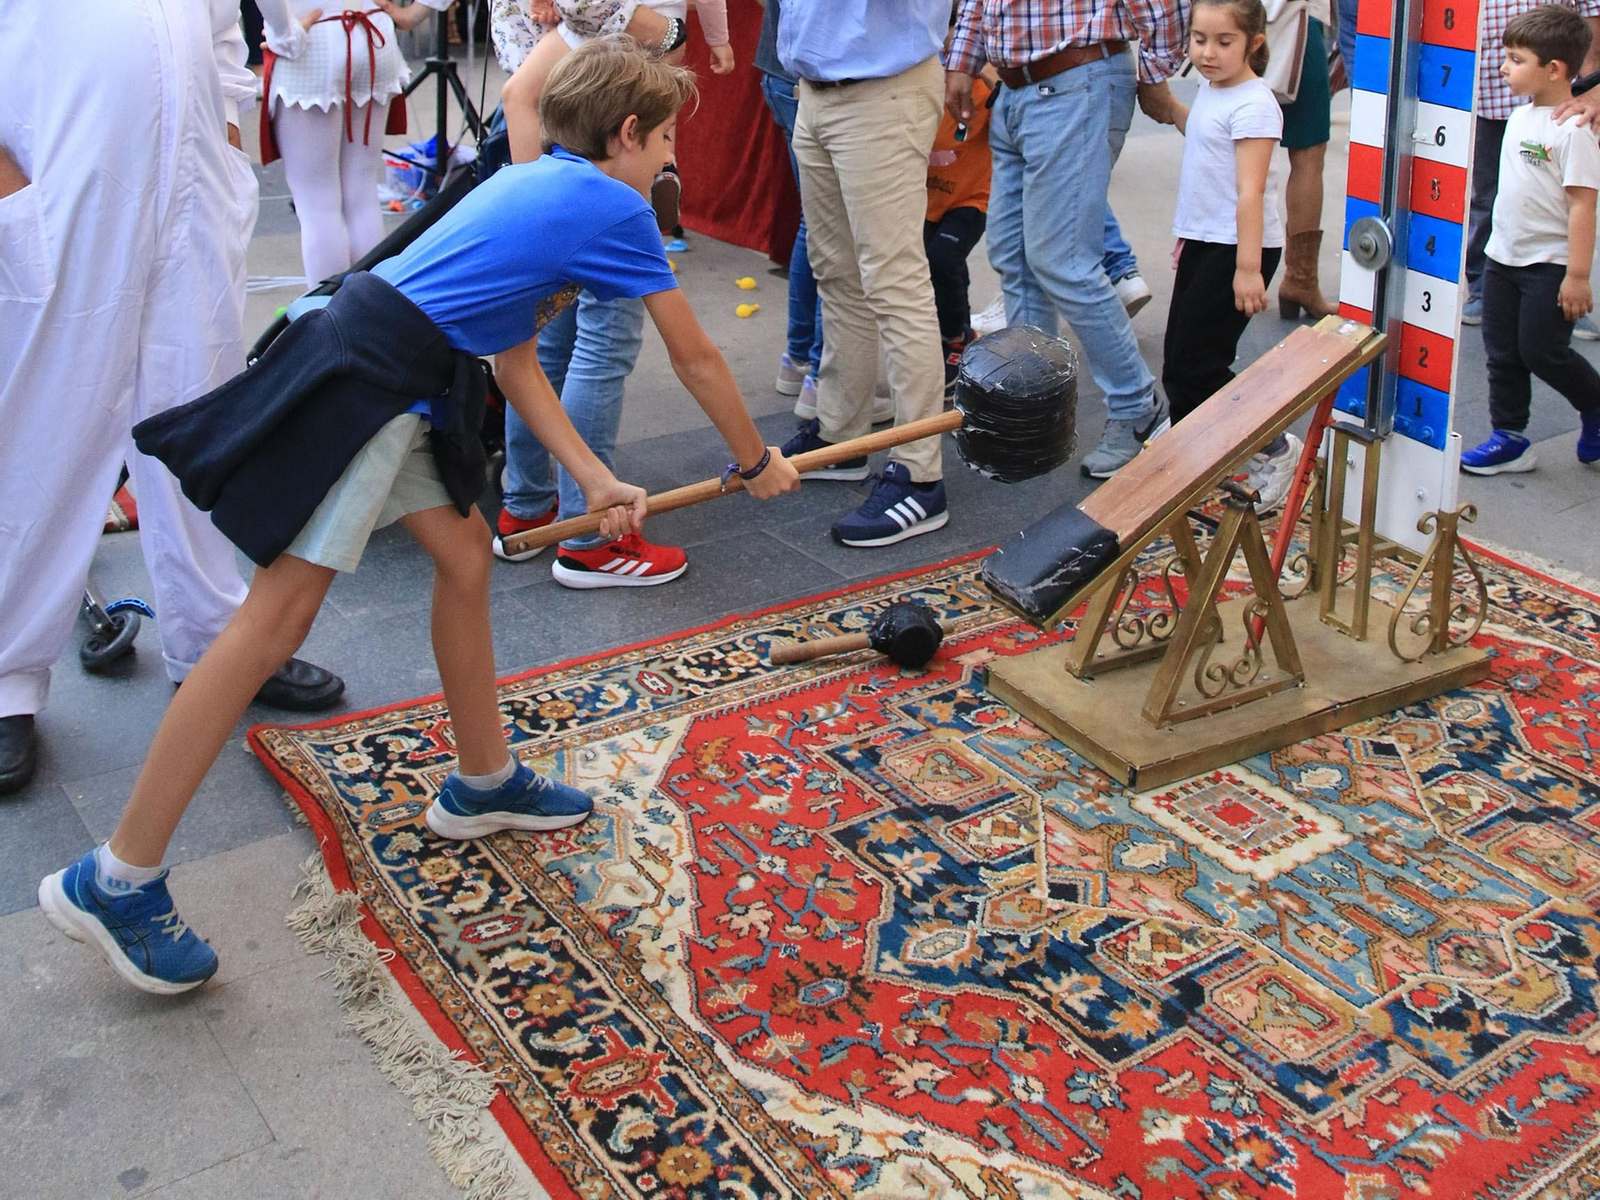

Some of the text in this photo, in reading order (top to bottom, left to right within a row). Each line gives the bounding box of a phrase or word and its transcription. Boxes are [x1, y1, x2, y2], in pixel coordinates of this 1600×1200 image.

[1443, 7, 1455, 30] 8
[1441, 64, 1452, 87] 7
[1435, 125, 1446, 147] 6
[1430, 178, 1441, 201] 5
[1424, 235, 1436, 257] 4
[1421, 291, 1432, 312] 3
[1418, 346, 1428, 368] 2
[1415, 396, 1423, 418] 1
